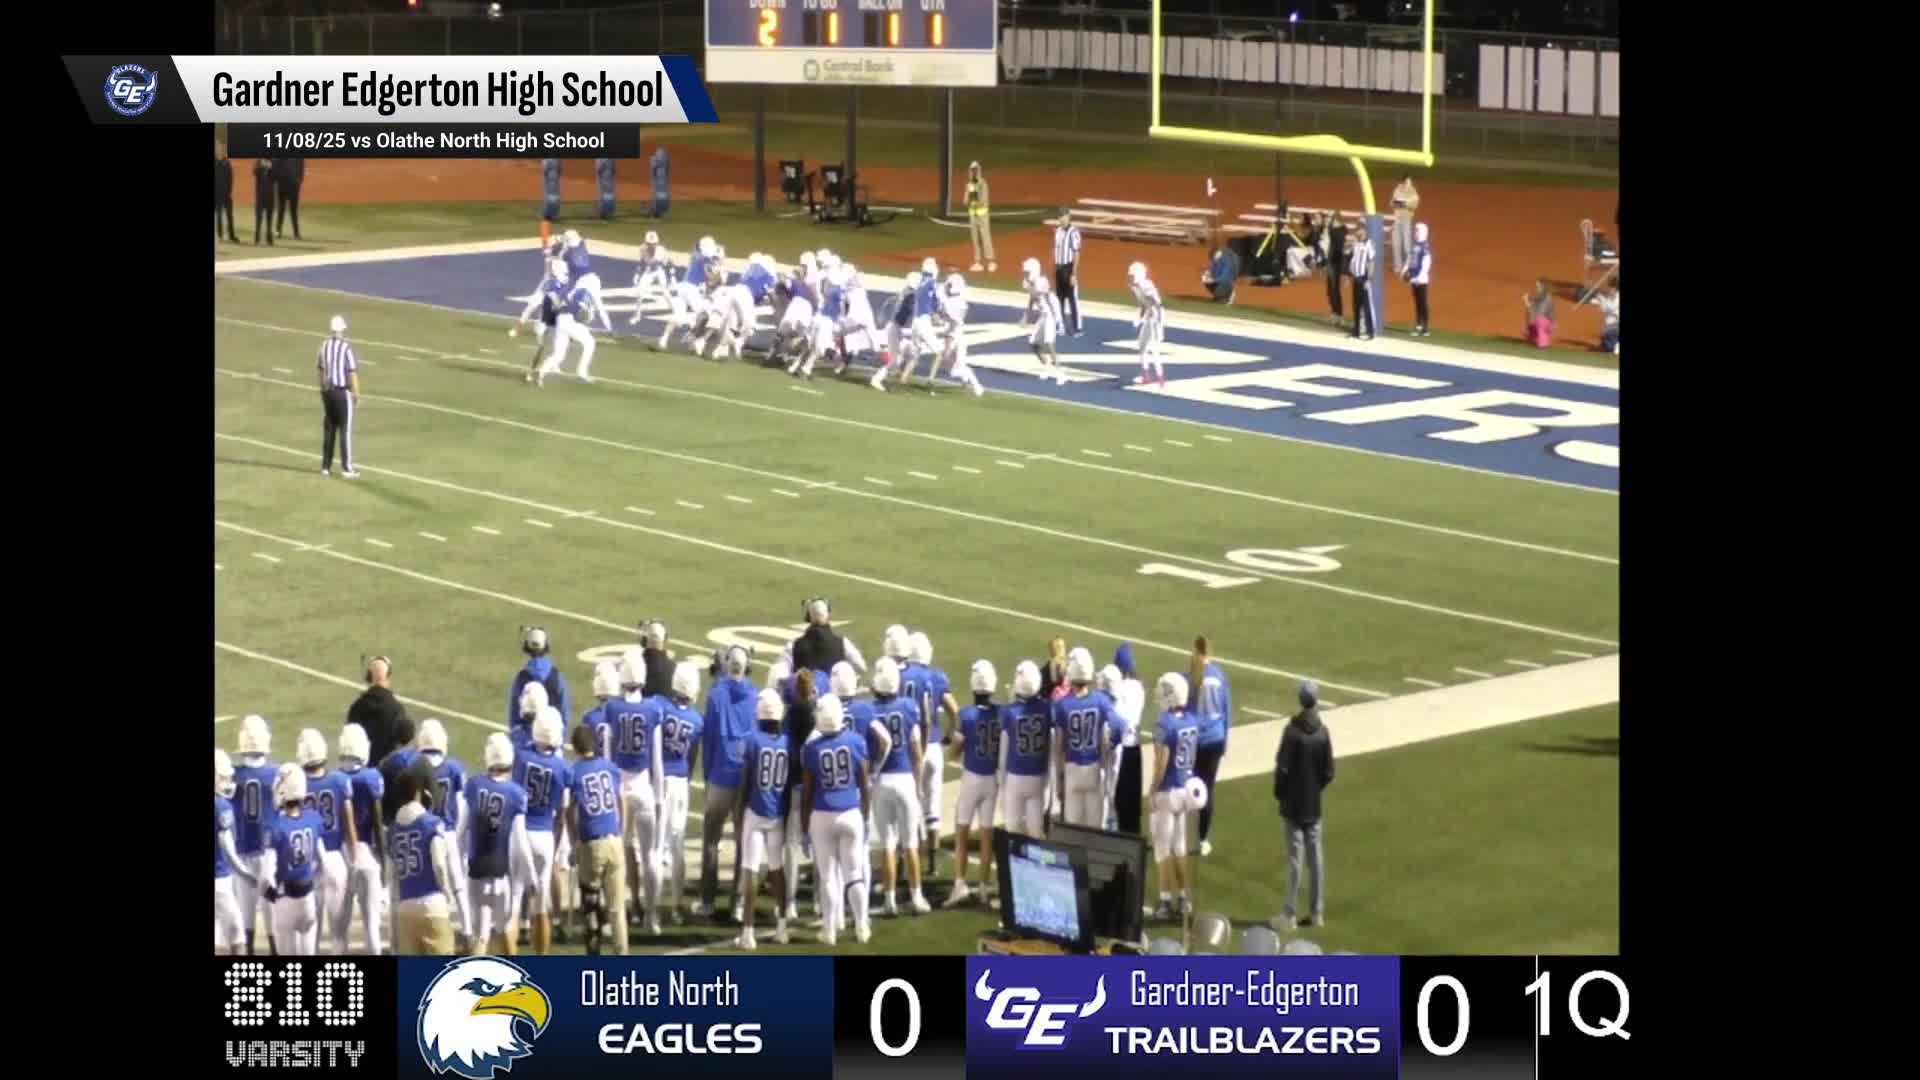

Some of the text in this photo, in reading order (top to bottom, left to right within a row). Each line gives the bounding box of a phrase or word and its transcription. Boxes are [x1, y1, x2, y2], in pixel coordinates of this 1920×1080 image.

[758, 9, 778, 47] 2
[829, 12, 839, 44] 1
[890, 12, 900, 46] 1
[932, 13, 943, 46] 1
[1136, 548, 1342, 588] 10
[618, 713, 646, 755] 16
[1069, 710, 1098, 750] 97
[757, 746, 788, 792] 80
[819, 745, 850, 790] 99
[581, 770, 617, 817] 58
